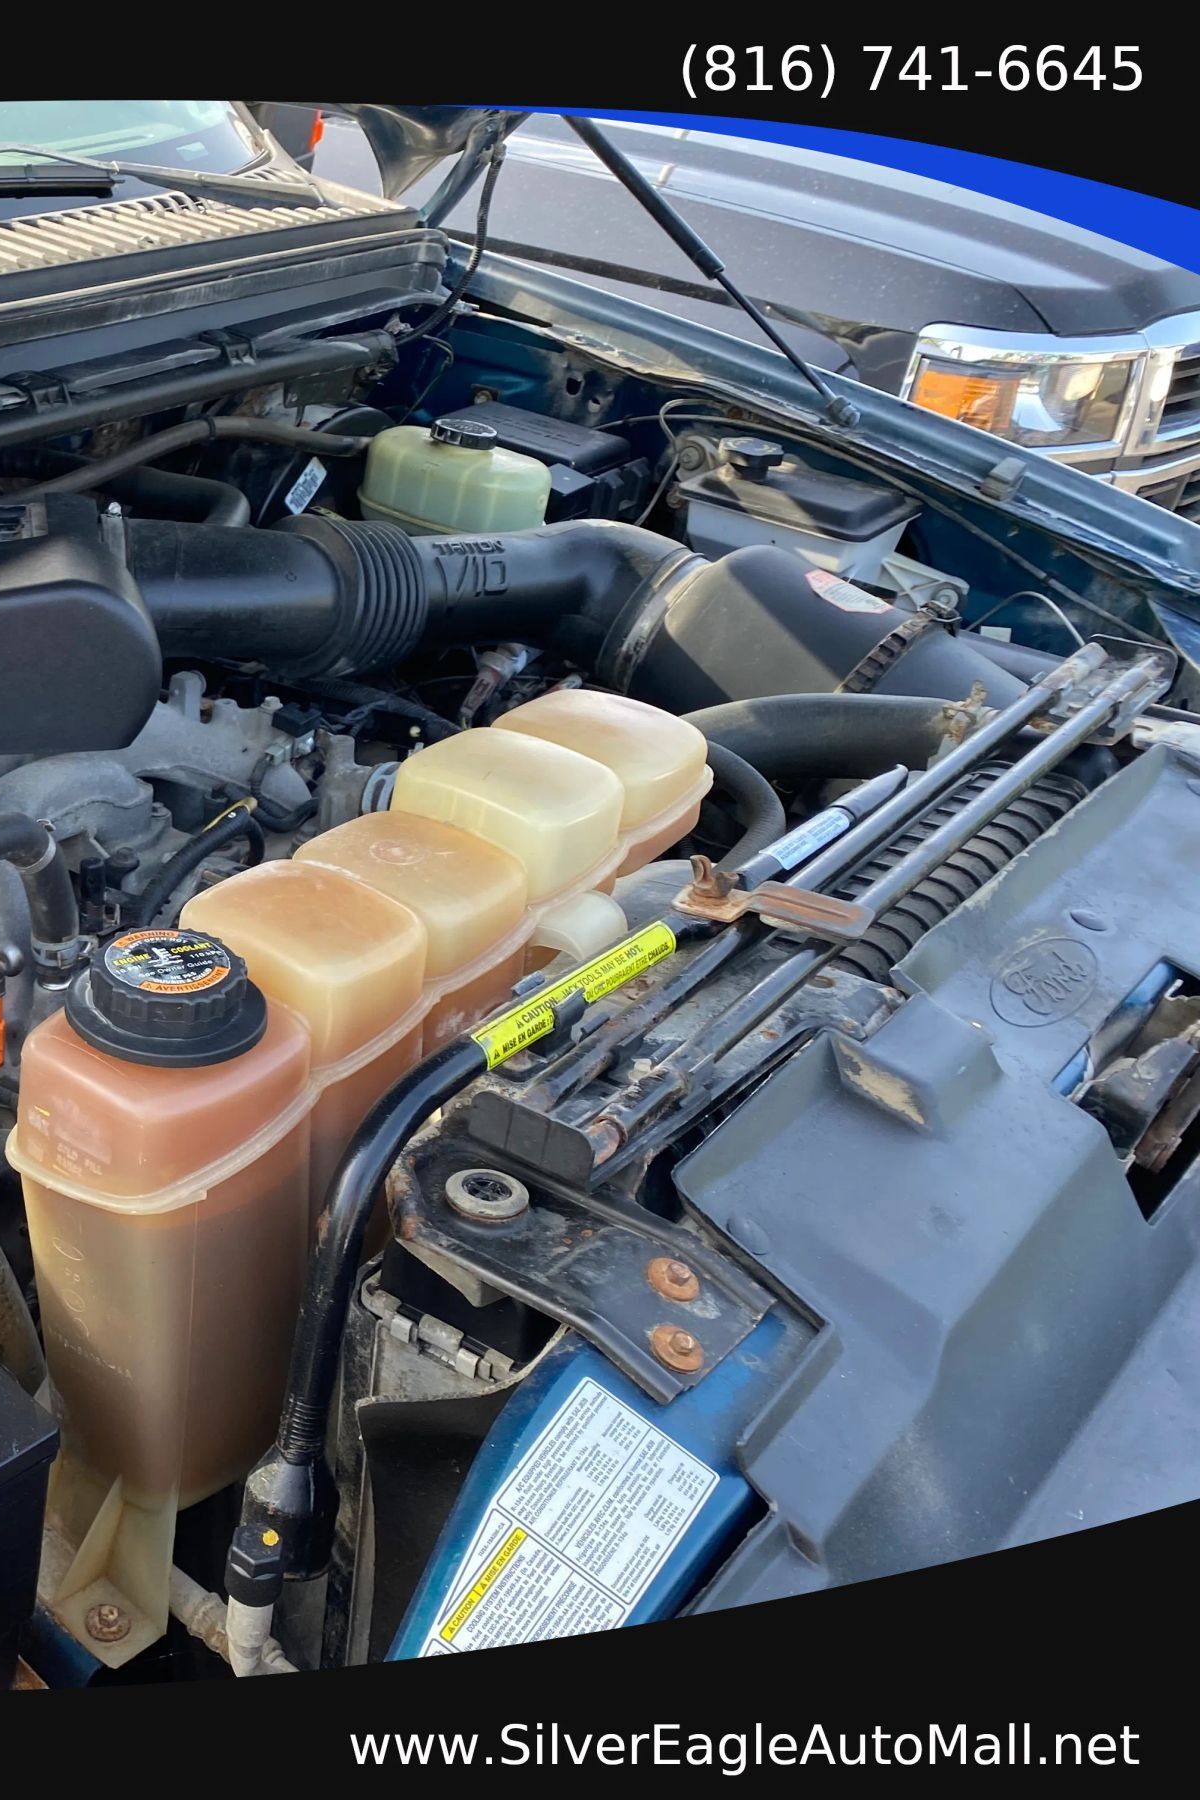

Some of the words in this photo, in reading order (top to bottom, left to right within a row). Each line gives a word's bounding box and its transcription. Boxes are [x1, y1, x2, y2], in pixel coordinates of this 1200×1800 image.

[112, 953, 151, 967] ENGINE
[170, 942, 213, 955] COOLANT
[188, 959, 213, 969] Guide
[578, 969, 602, 987] TOOLS
[599, 960, 615, 973] MAY
[614, 953, 626, 965] BE
[515, 1481, 524, 1492] A/C
[521, 1460, 540, 1483] EQUIPPED
[538, 1439, 556, 1460] VEHICLES
[554, 1425, 568, 1441] comply
[565, 1415, 573, 1425] with
[534, 1487, 556, 1516] CONDITIONER
[555, 1459, 576, 1487] REFRIGERANT
[484, 1565, 498, 1582] MISE
[495, 1556, 505, 1566] EN
[503, 1534, 521, 1556] GARDE
[526, 1567, 536, 1579] Ford
[535, 1552, 548, 1568] coolant
[466, 1609, 485, 1632] COOLING
[482, 1589, 499, 1610] SYSTEM
[496, 1554, 525, 1590] INSTRUCTIONS
[531, 1585, 544, 1602] coolant
[452, 1598, 474, 1626] CAUTION
[471, 1629, 482, 1641] Ford
[481, 1610, 495, 1629] coolant
